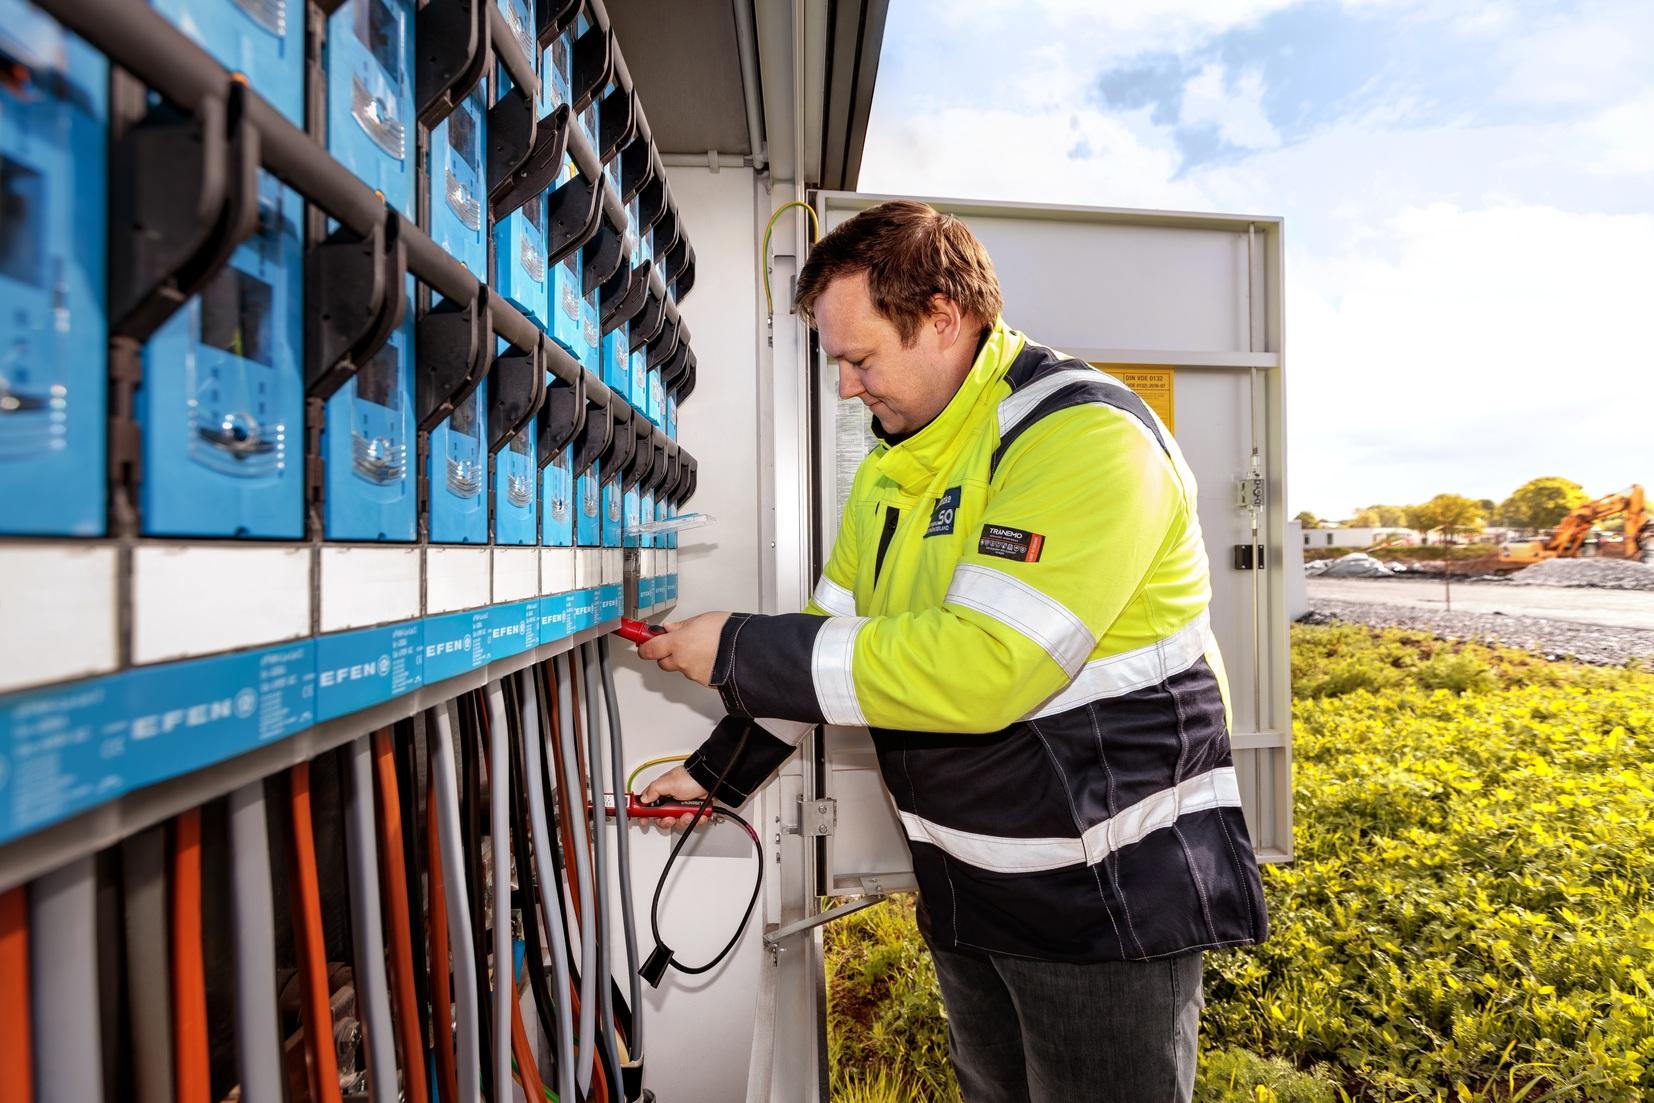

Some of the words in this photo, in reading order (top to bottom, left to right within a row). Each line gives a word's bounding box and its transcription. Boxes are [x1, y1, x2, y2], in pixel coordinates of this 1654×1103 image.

[989, 527, 1023, 539] TRANEMO
[575, 606, 592, 616] EFEN
[602, 600, 617, 609] EFEN
[541, 614, 562, 625] EFEN
[492, 624, 519, 639] EFEN
[426, 639, 463, 658] EFEN
[319, 661, 377, 687] EFEN
[130, 698, 233, 740] EFEN
